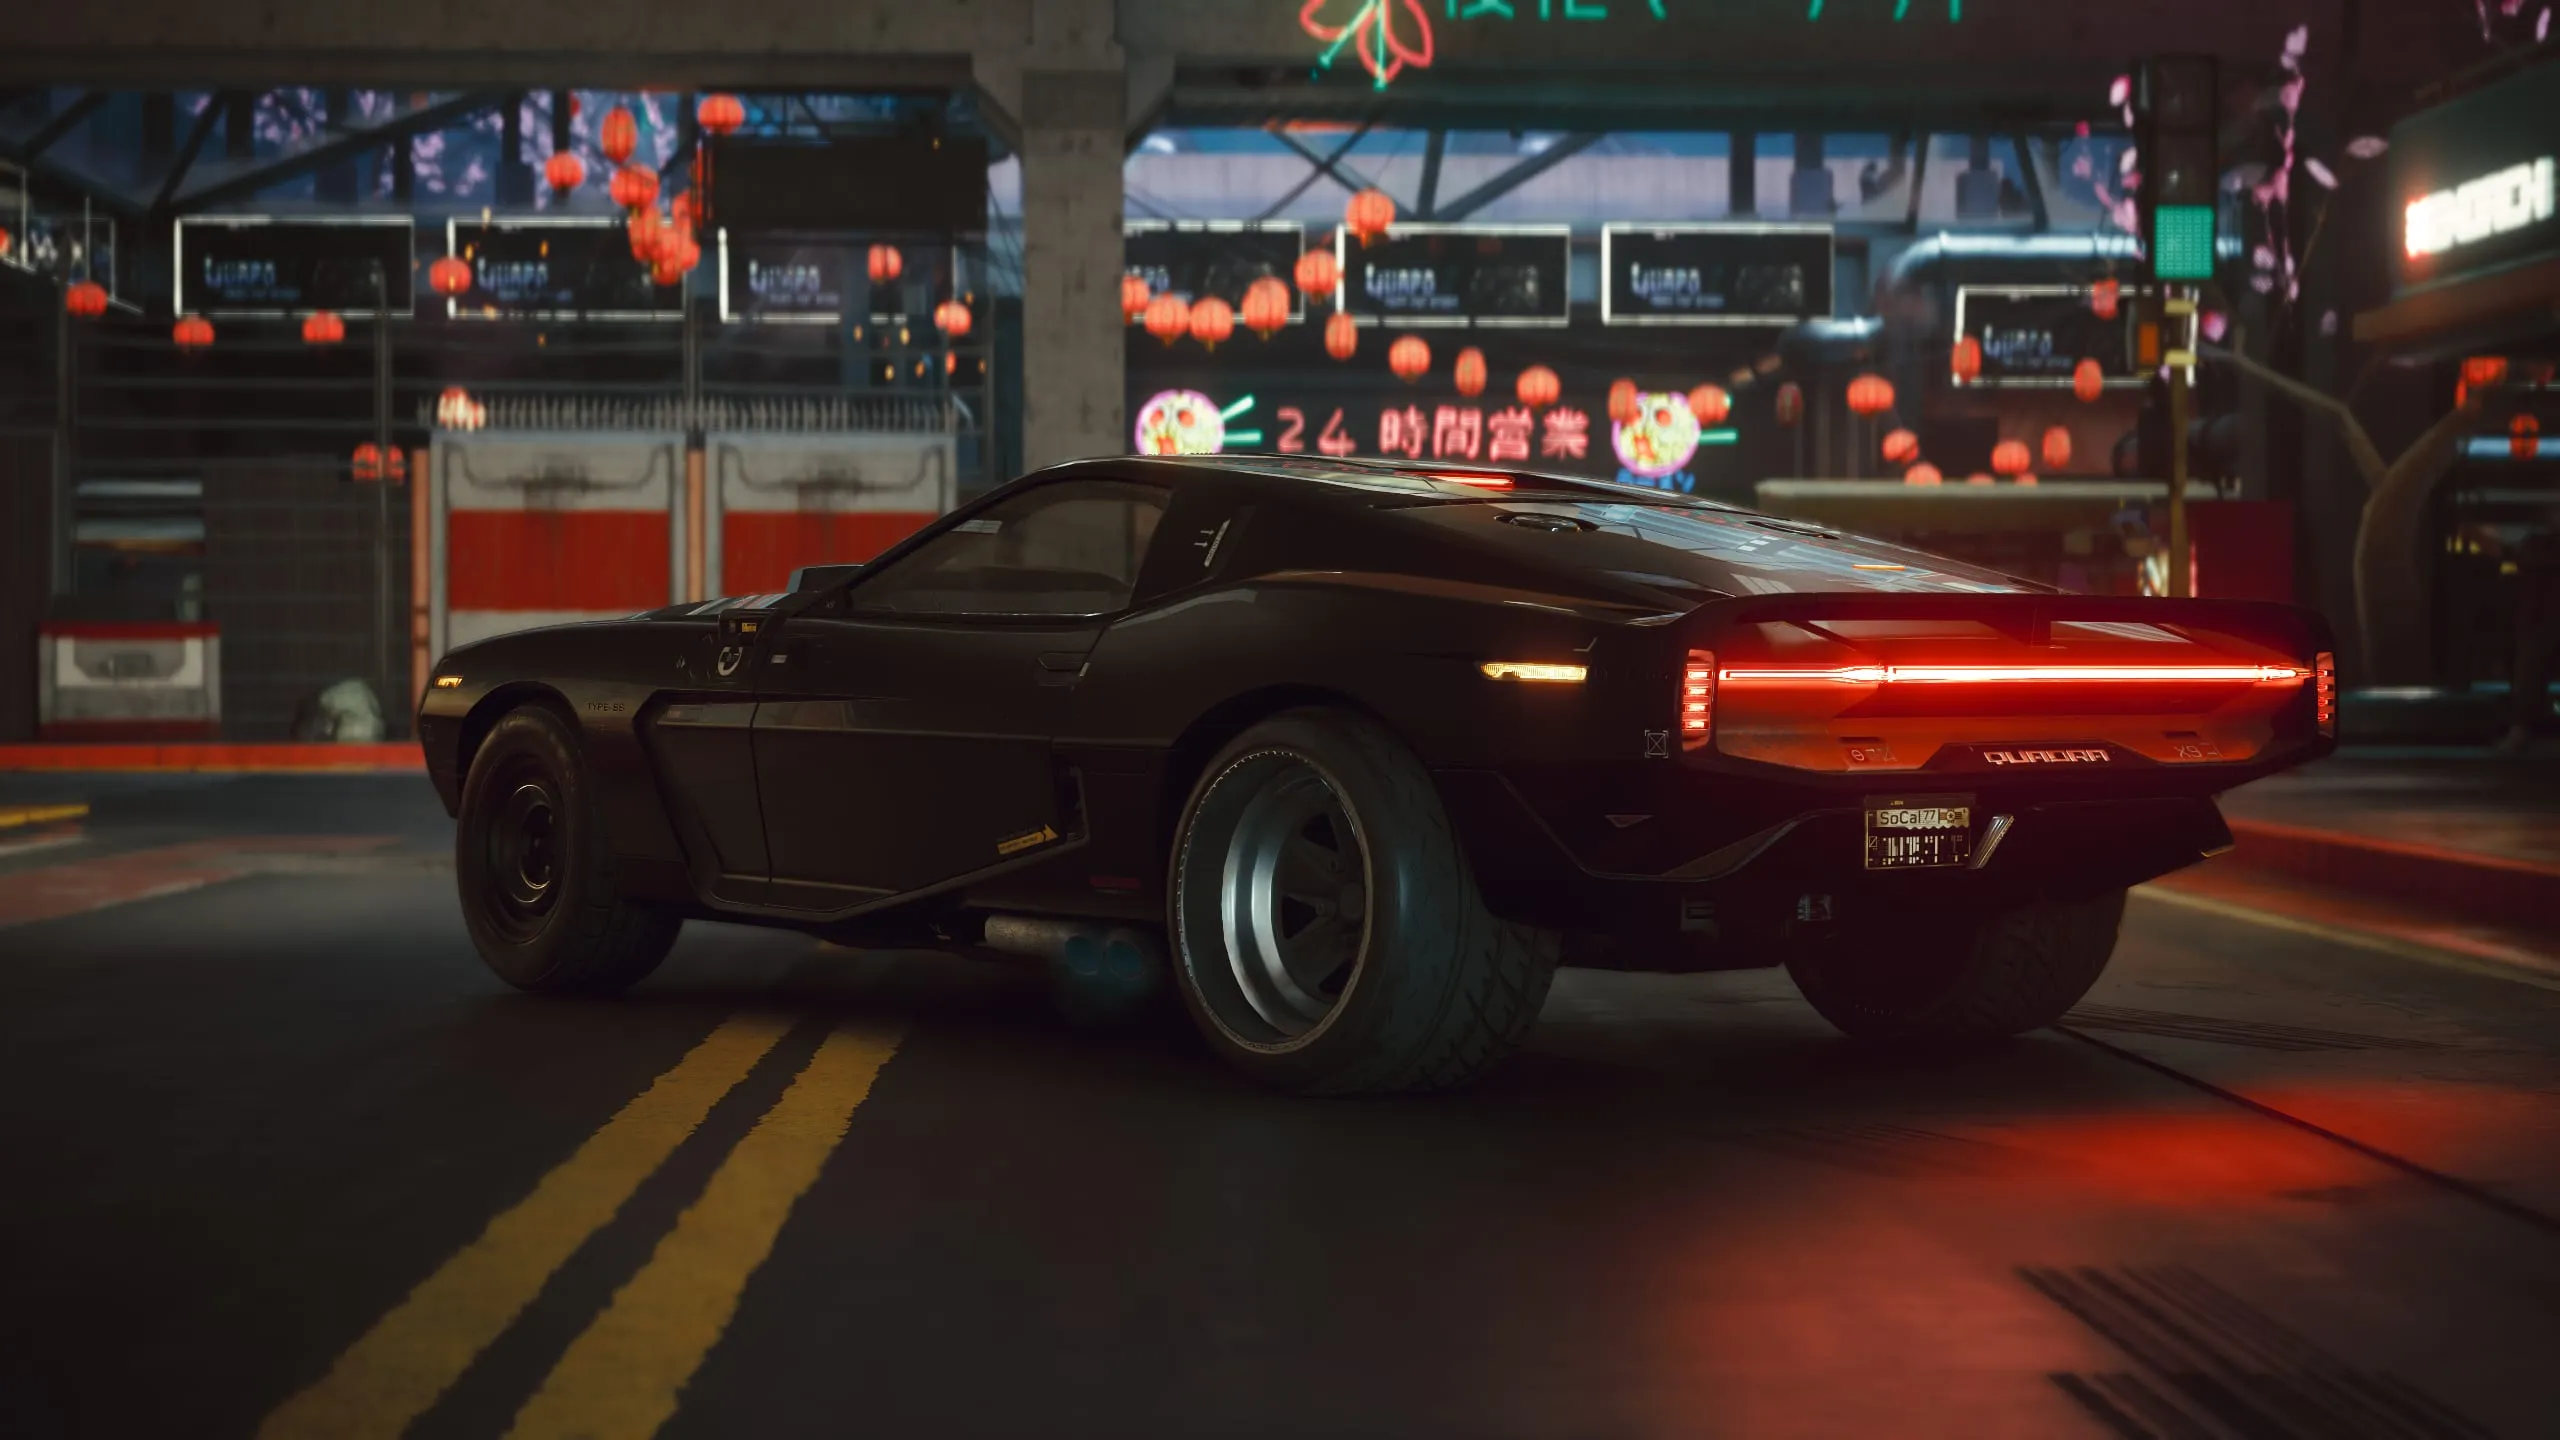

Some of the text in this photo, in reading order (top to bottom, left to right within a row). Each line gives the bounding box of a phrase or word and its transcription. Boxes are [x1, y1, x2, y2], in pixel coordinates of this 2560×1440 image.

[1277, 407, 1356, 456] 24
[1984, 750, 2111, 765] QUADRA
[1879, 809, 1936, 825] SoCal 77
